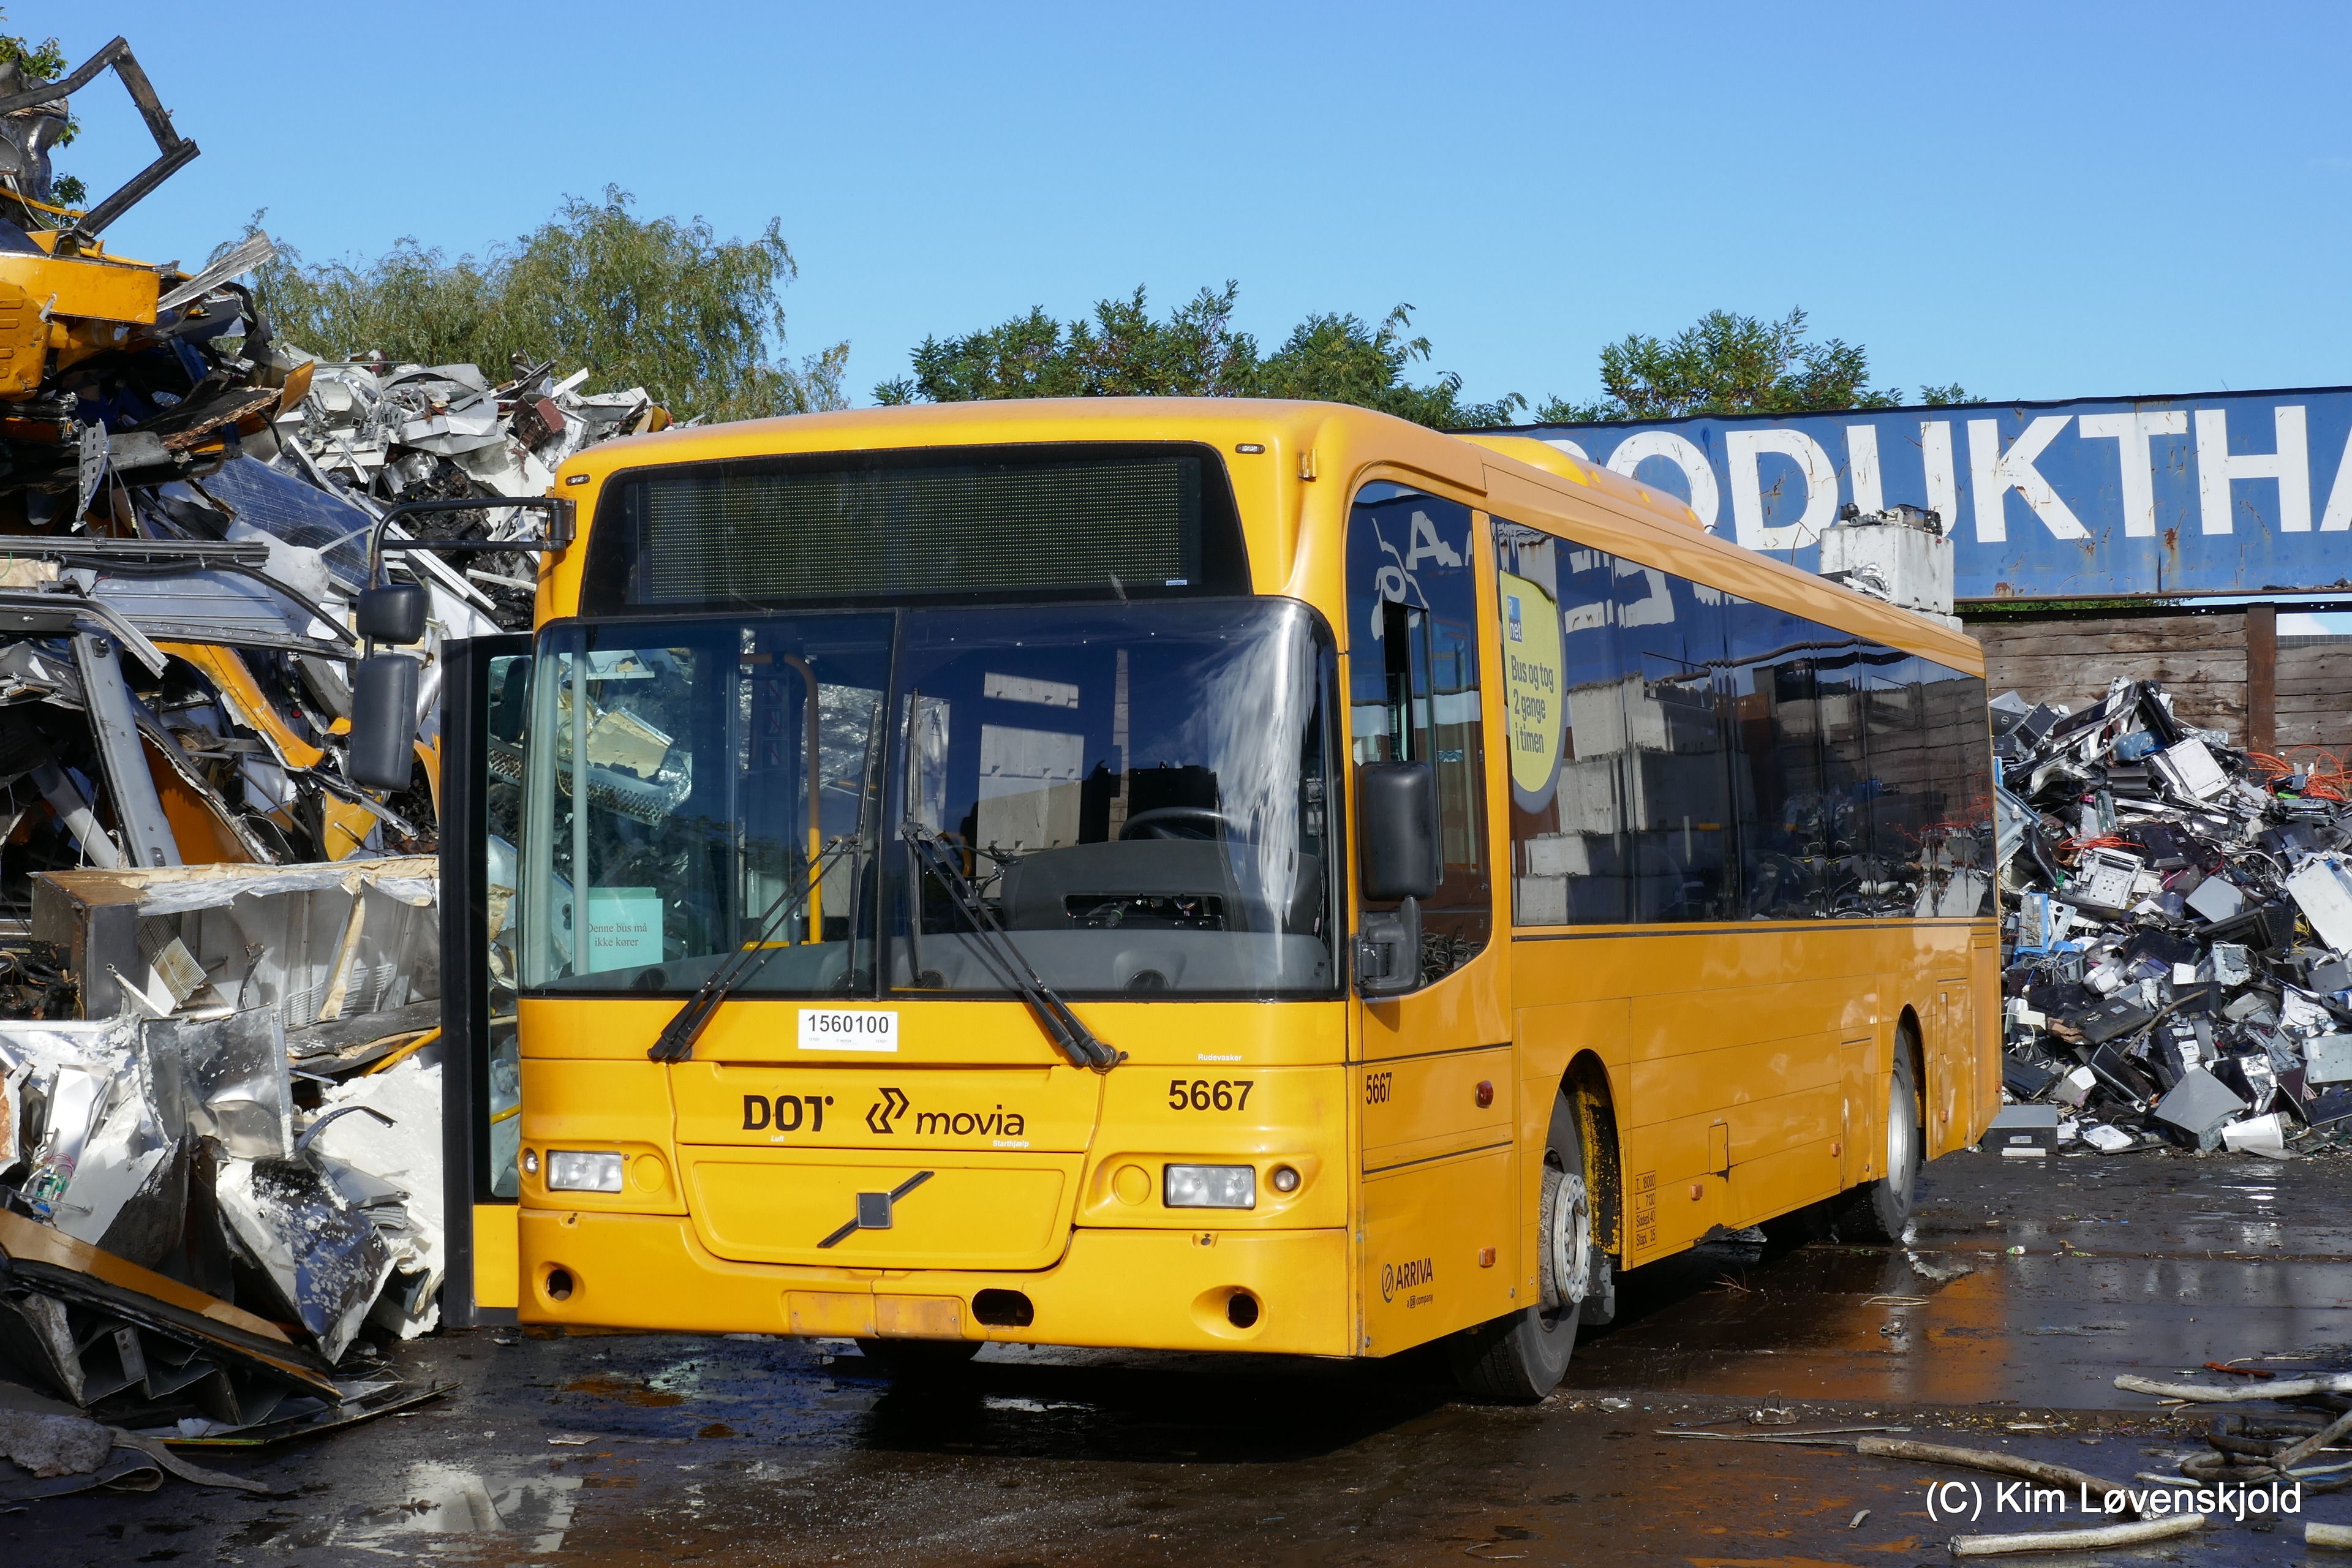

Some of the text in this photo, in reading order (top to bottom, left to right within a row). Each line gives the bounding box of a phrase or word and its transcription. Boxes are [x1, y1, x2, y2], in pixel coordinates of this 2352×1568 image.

[1541, 405, 2352, 550] ODUKTH
[1508, 598, 1513, 616] R
[1509, 622, 1521, 640] net
[1510, 654, 1554, 694] Bus og tog
[1513, 688, 1546, 724] 2 gange
[1515, 722, 1544, 753] i timen
[588, 922, 647, 933] Denne bus må
[595, 937, 639, 946] ikke kører
[809, 1014, 889, 1034] 1560100
[1168, 1080, 1254, 1111] 5667
[1366, 1072, 1392, 1105] 5667
[742, 1095, 825, 1132] DOT
[916, 1104, 1025, 1136] movia
[992, 1140, 1029, 1149] Starthjælp
[1643, 1174, 1655, 1189] 18000
[1636, 1193, 1655, 1210] L 7130
[1650, 1210, 1655, 1223] 40
[1650, 1228, 1656, 1242] 35
[1396, 1257, 1433, 1291] ARRIVA
[1416, 1294, 1433, 1306] company
